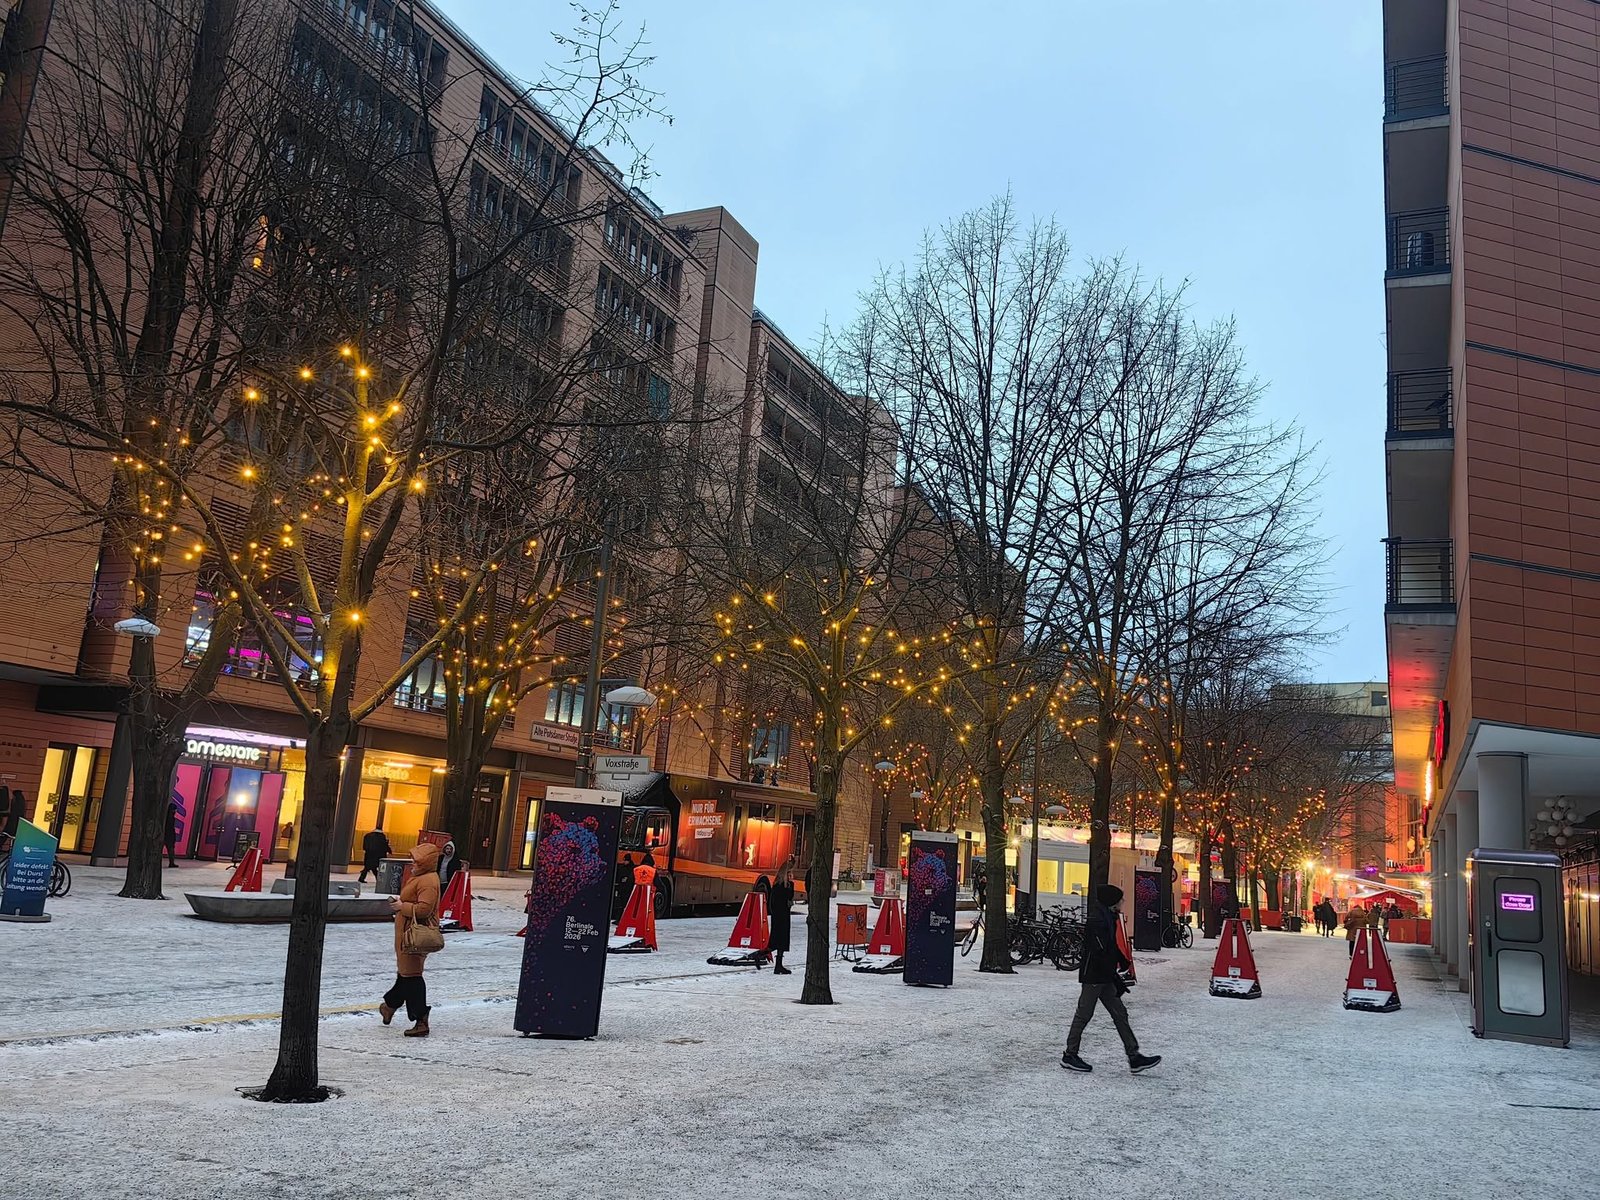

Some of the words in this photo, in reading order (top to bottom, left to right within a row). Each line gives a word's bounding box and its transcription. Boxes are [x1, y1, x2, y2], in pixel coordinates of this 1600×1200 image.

[533, 726, 543, 737] Alte
[543, 728, 565, 741] Potsdamer
[605, 758, 639, 770] Voxstraße
[692, 803, 704, 814] NUR
[704, 800, 716, 814] FÜR
[12, 876, 27, 884] bitte
[566, 915, 577, 923] 76.
[565, 921, 594, 930] Berlinale
[564, 933, 581, 941] 2026
